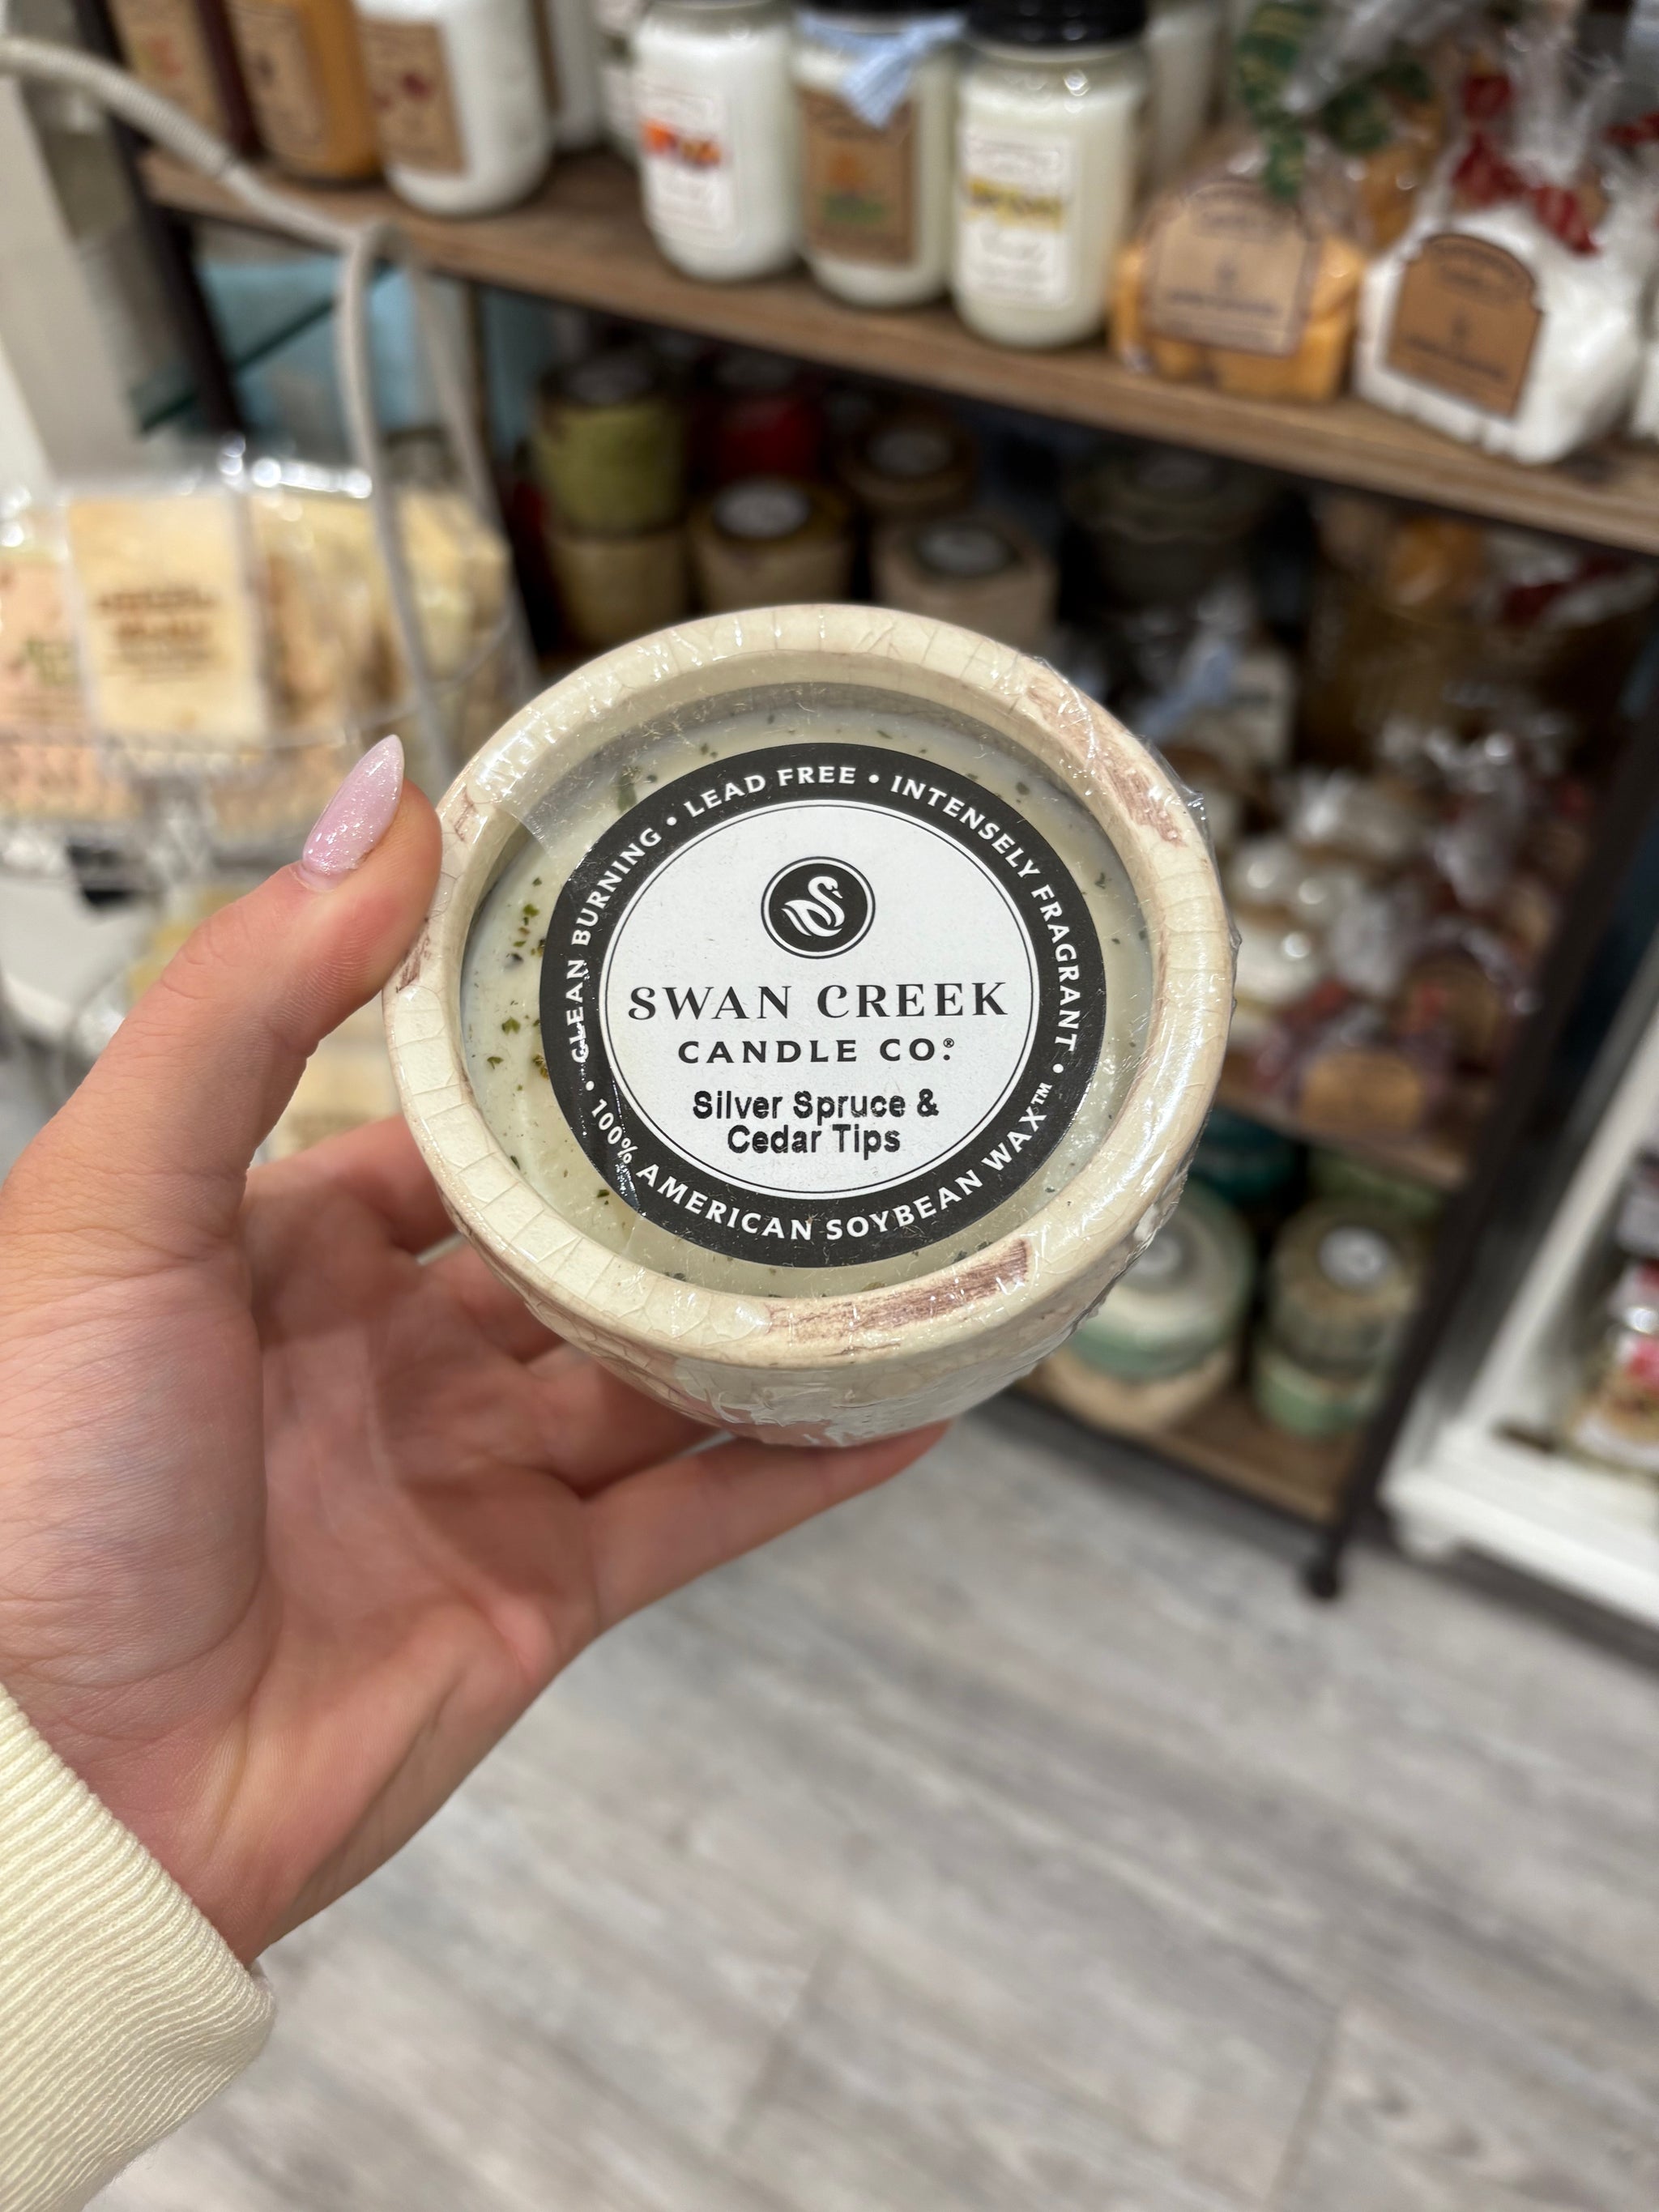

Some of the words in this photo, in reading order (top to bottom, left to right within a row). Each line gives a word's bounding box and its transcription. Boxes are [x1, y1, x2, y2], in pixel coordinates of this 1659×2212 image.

[683, 773, 767, 820] LEAD
[776, 765, 858, 787] FREE
[572, 827, 662, 946] BURNING
[890, 774, 1041, 880] INTENSELY
[1030, 884, 1081, 1054] FRAGRANT
[565, 959, 590, 1064] CLEAN
[627, 985, 793, 1021] SWAN
[817, 981, 1009, 1017] CREEK
[677, 1039, 859, 1064] CANDLE
[692, 1089, 783, 1120] Silver
[792, 1089, 906, 1126] Spruce
[917, 1089, 939, 1117] &
[591, 1098, 638, 1166] 100%
[636, 1162, 812, 1241] AMERICAN
[825, 1170, 984, 1240] SOYBEAN
[727, 1125, 823, 1156] Cedar
[831, 1123, 901, 1161] Tips
